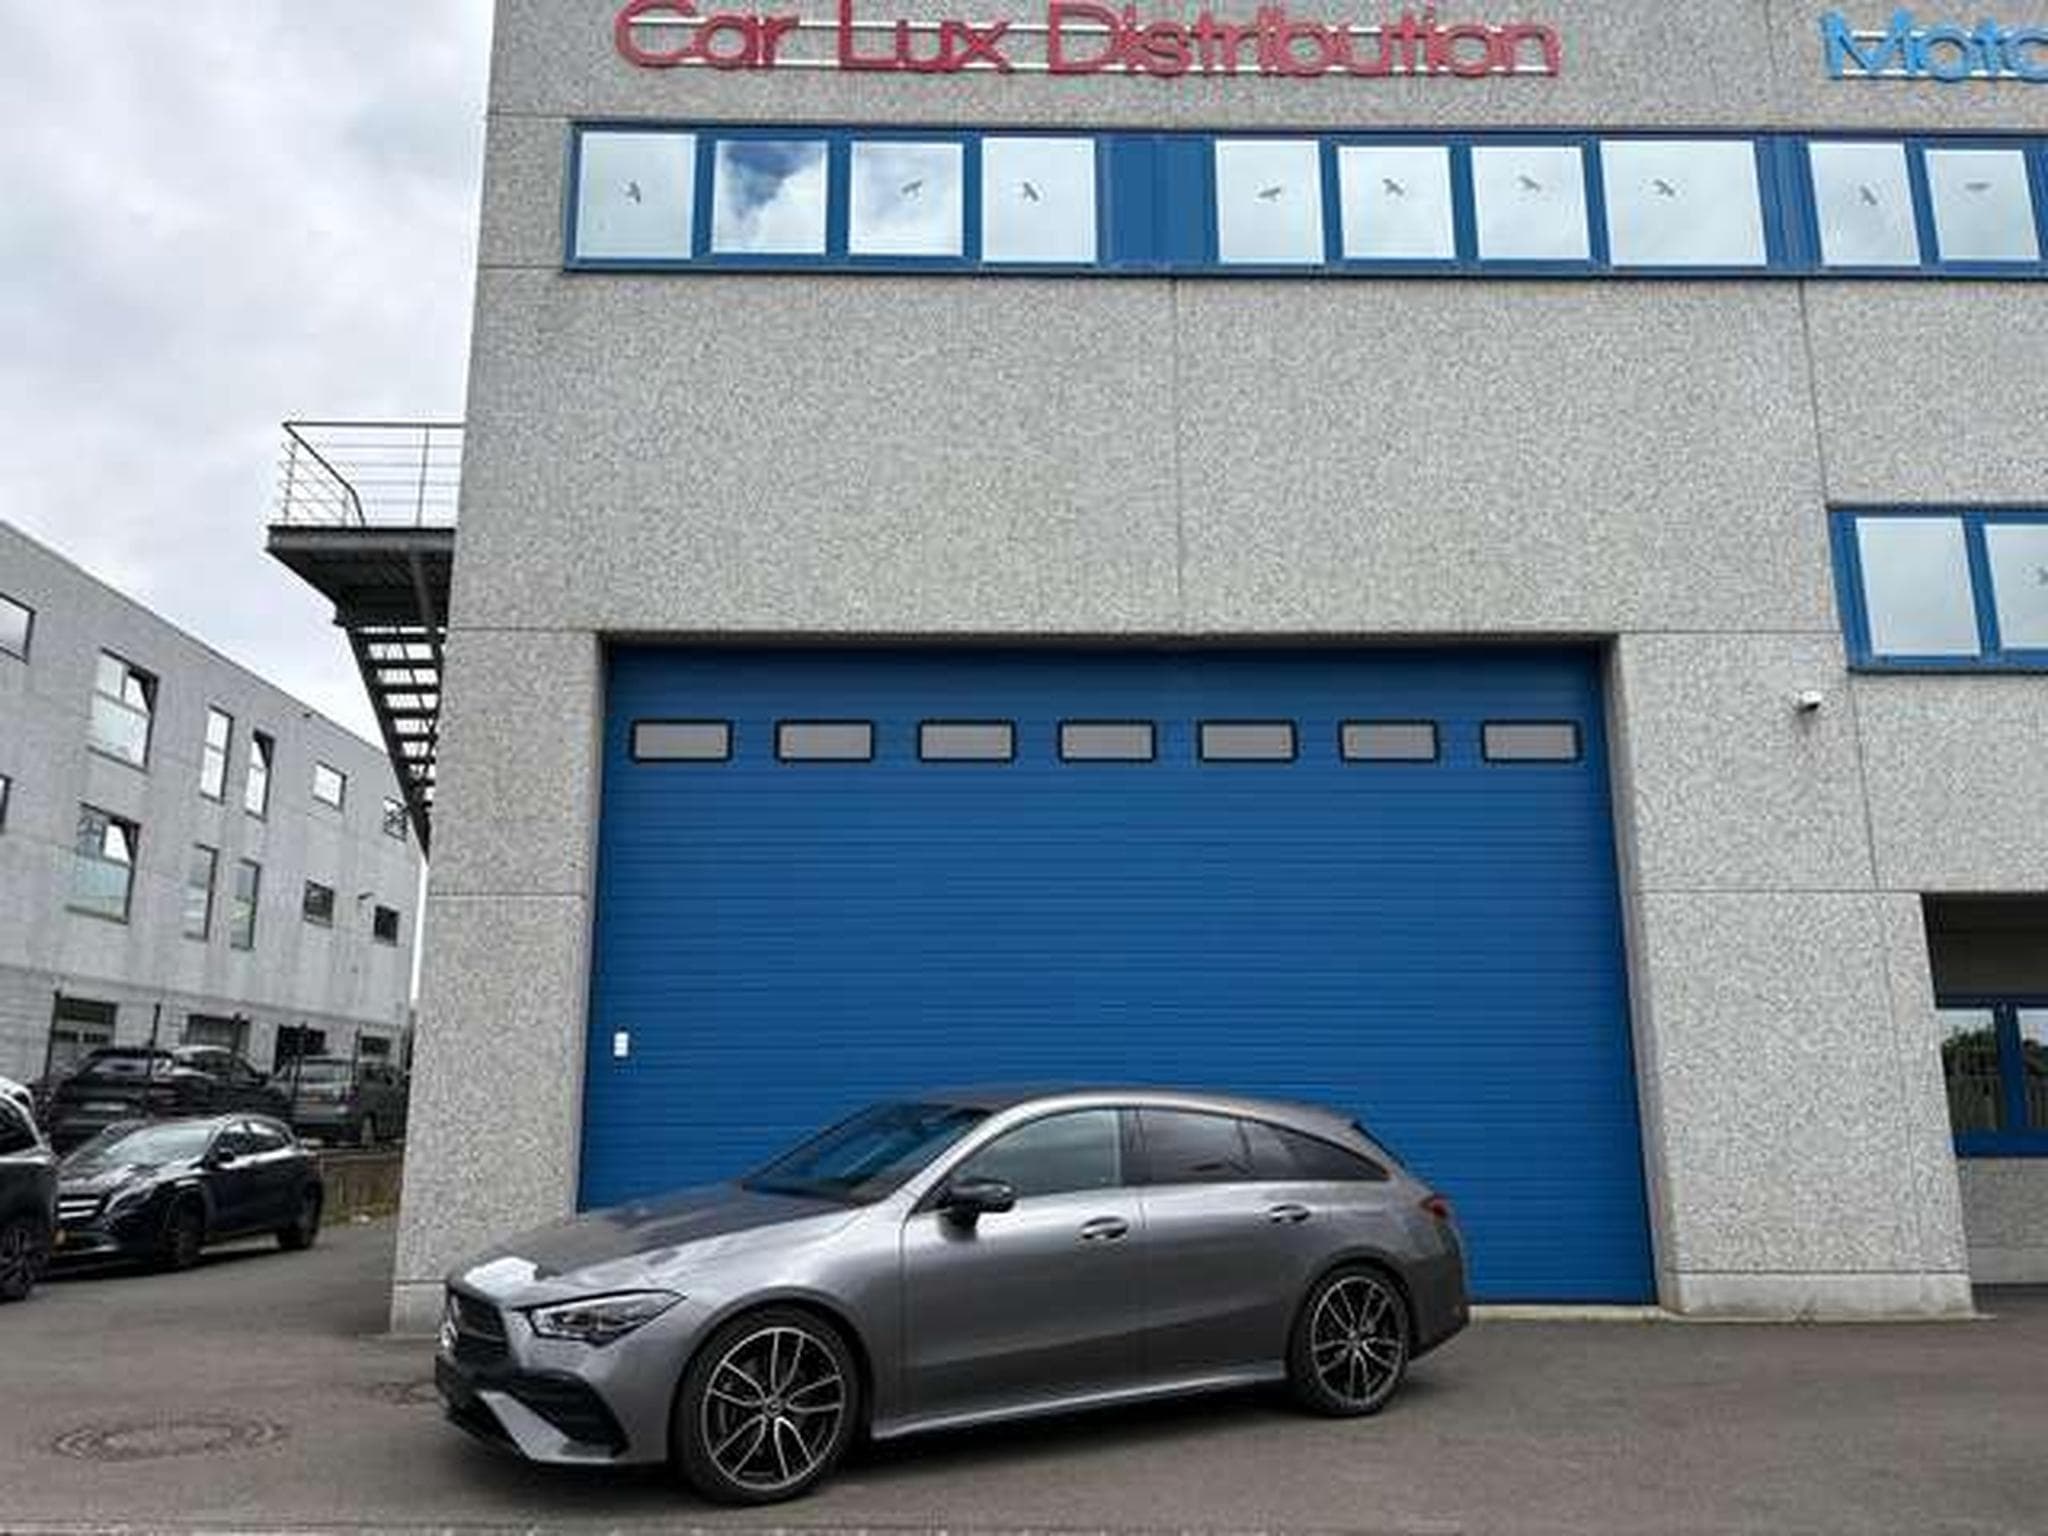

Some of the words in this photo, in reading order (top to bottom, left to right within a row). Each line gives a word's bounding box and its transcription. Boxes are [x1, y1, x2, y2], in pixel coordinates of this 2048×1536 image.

[614, 0, 799, 69] Car
[839, 0, 1010, 72] Lux
[1048, 2, 1561, 77] Distribution
